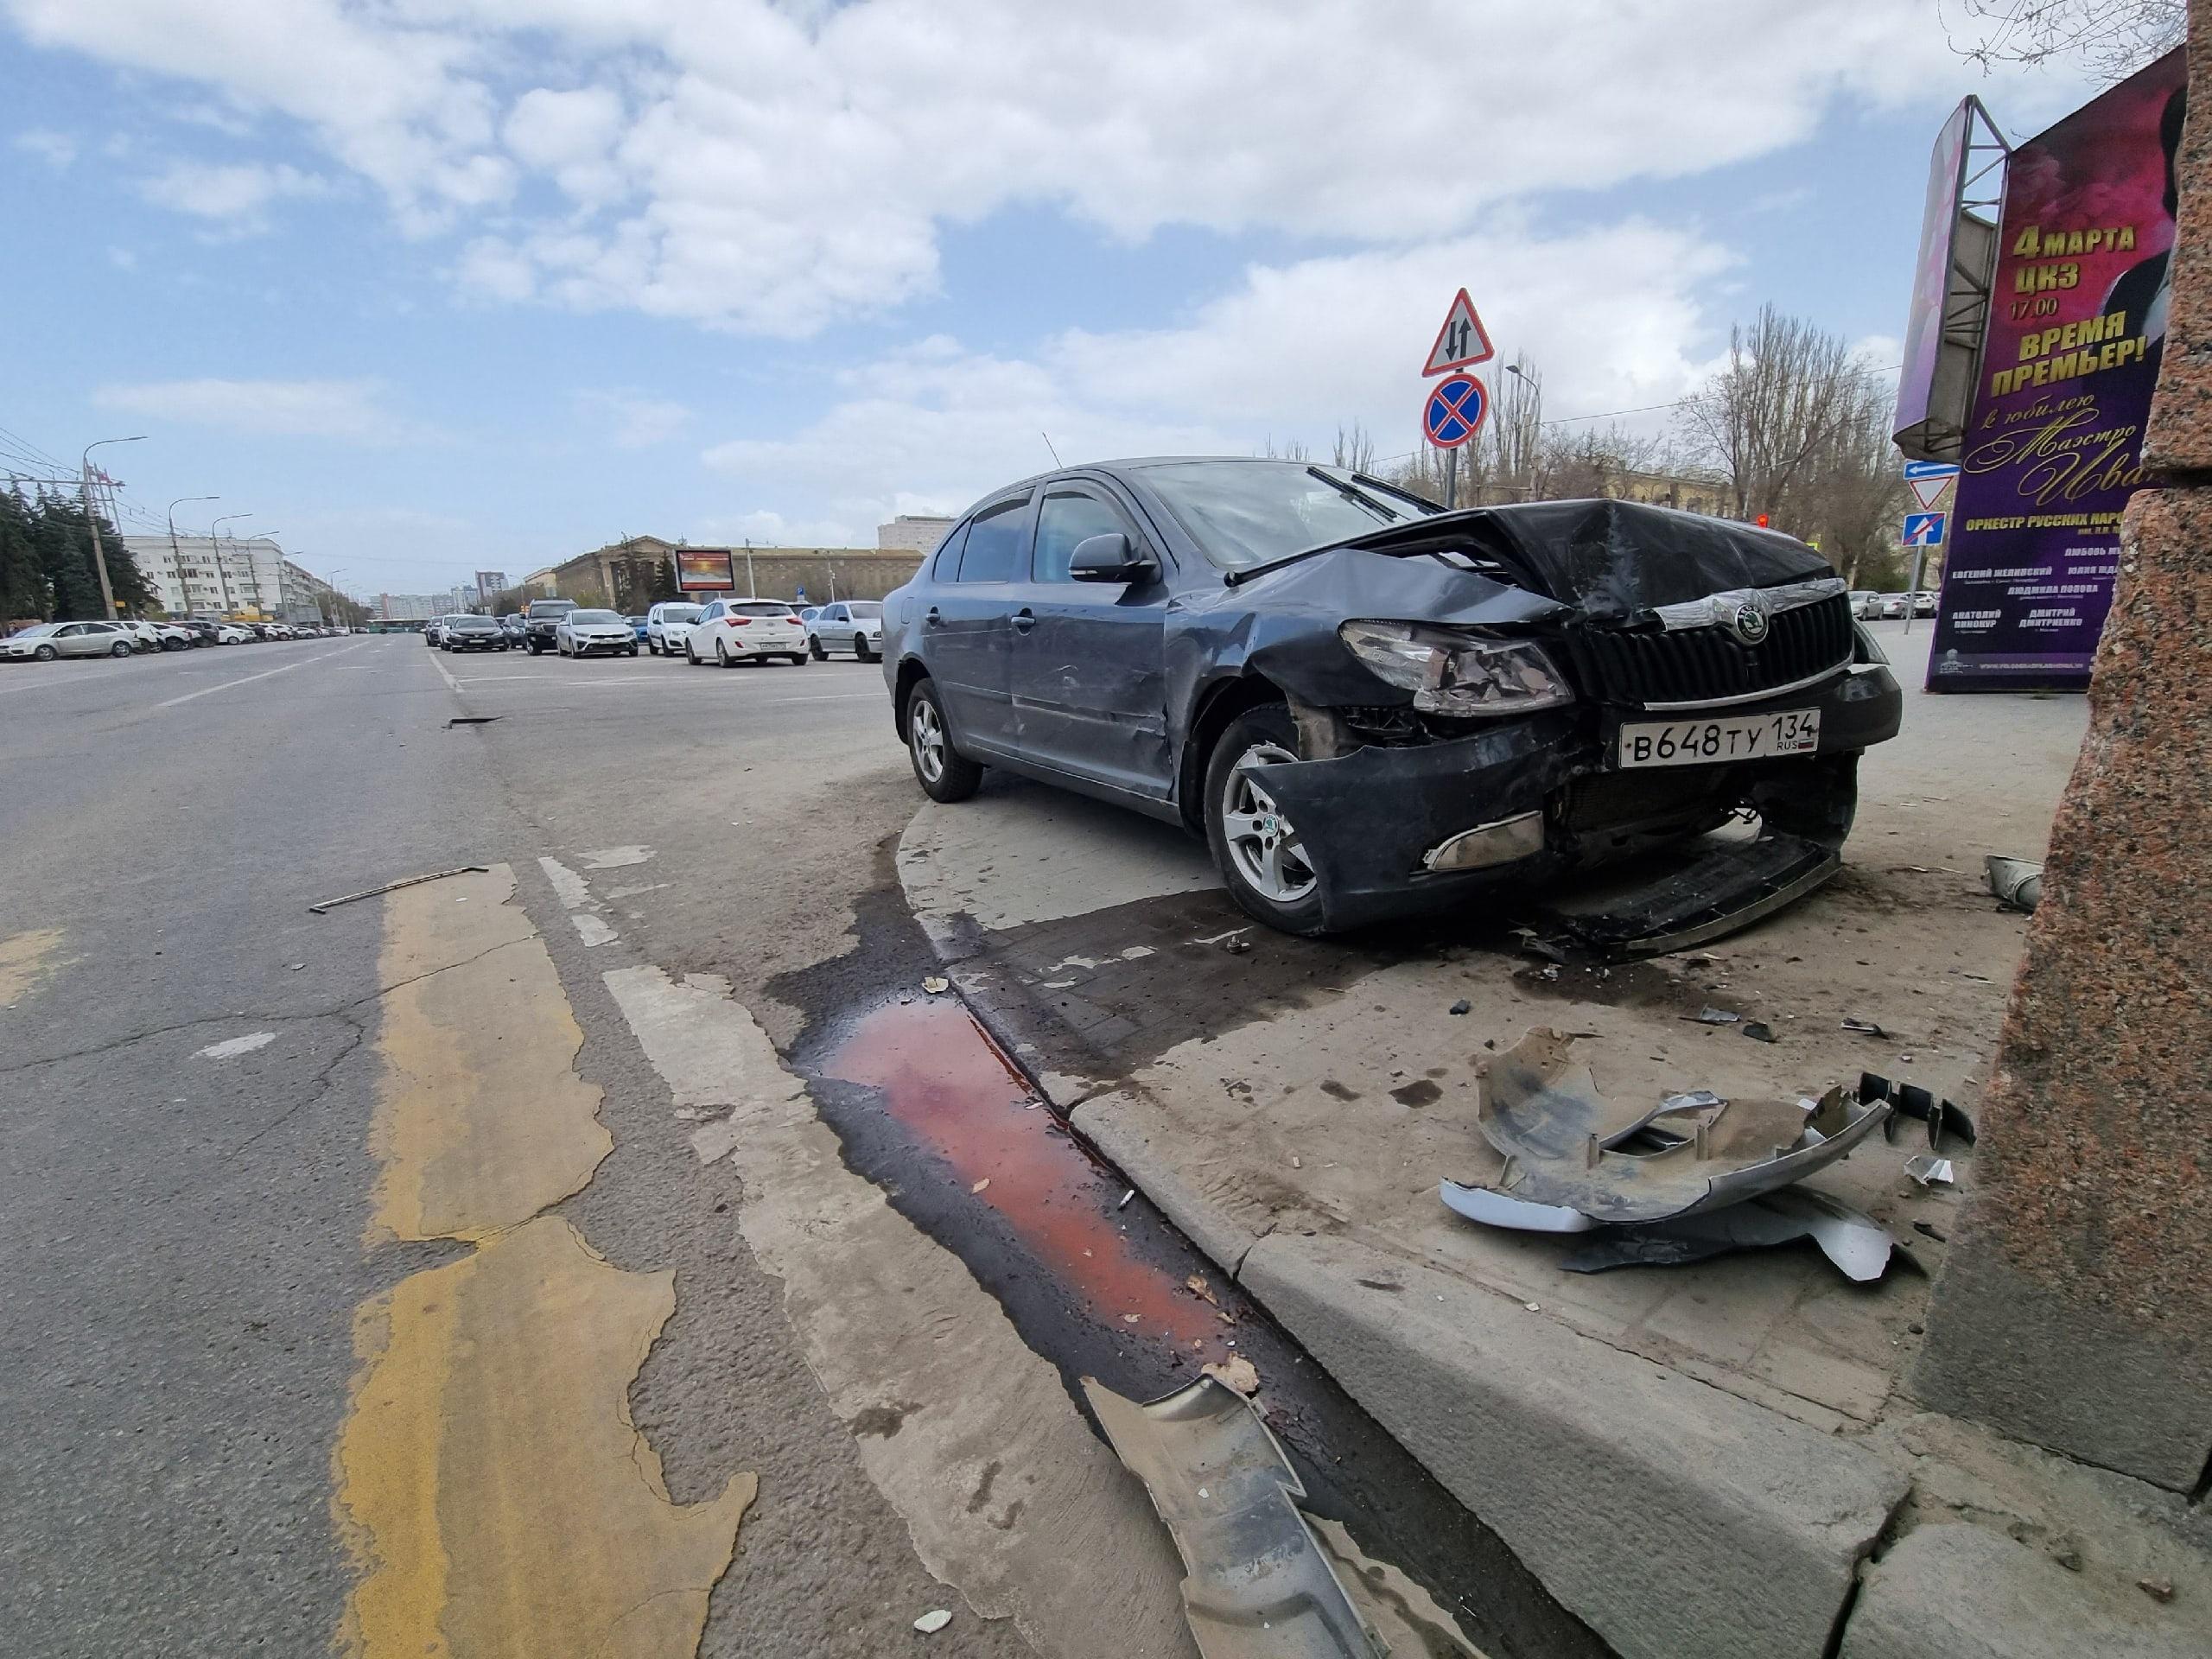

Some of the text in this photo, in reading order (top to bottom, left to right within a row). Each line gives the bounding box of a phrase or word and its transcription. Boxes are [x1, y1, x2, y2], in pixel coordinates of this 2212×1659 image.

[2013, 226, 2136, 260] 4 МАРТА
[2015, 263, 2080, 296] ЦКЗ
[2011, 297, 2058, 321] 17.00
[2018, 310, 2126, 362] ВРЕМЯ
[1991, 335, 2148, 397] ПРЕМЬЕР!
[1963, 407, 2137, 474] Маэстро
[2017, 438, 2153, 506] Ива
[1966, 512, 2125, 531] ОРКЕСТР РУССКИХ НАРО
[1952, 567, 1992, 579] ЕВГЕНИЙ
[2007, 585, 2059, 595] ЛЮДМИЛА
[1952, 608, 2002, 620] АНАТОЛИЙ
[2029, 607, 2075, 618] ДМИТРИЙ
[1771, 712, 1814, 741] 134
[1777, 741, 1798, 751] RUS
